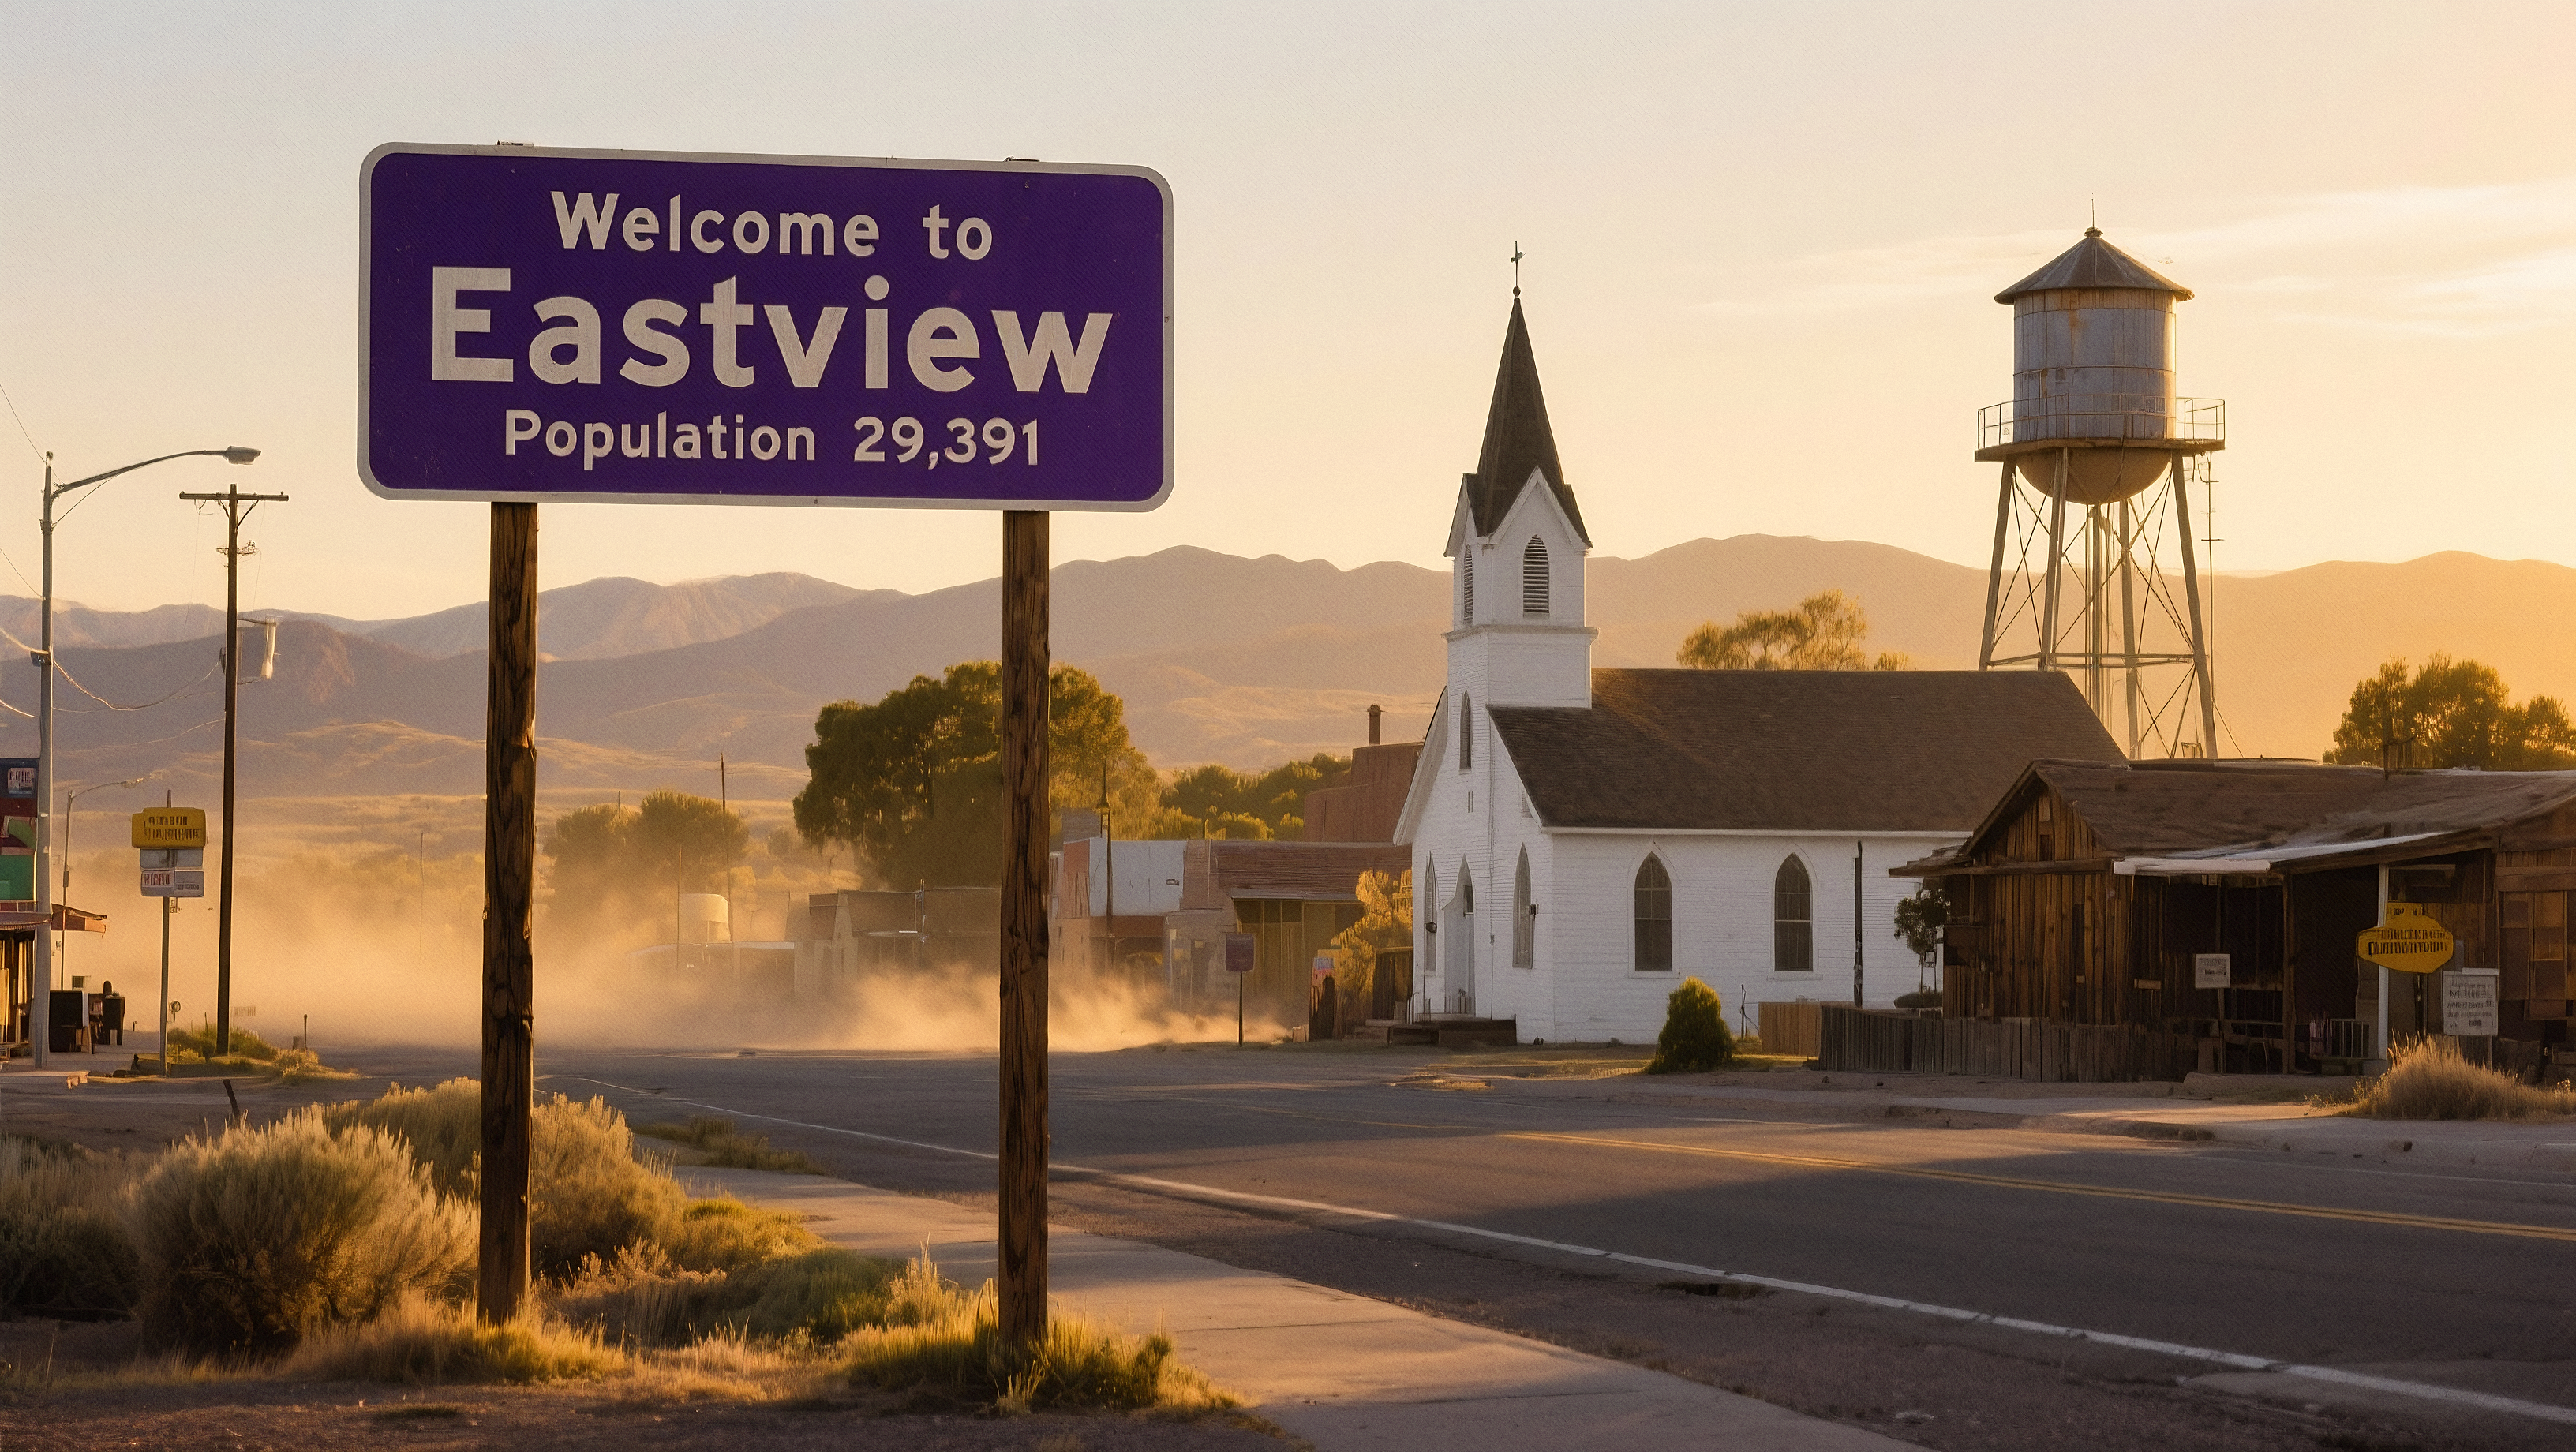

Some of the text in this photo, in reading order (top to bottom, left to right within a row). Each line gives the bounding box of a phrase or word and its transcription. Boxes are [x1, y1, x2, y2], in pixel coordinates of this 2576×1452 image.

[551, 190, 994, 261] Welcome to
[431, 265, 1114, 395] Eastview
[504, 408, 1039, 471] Population 29,391
